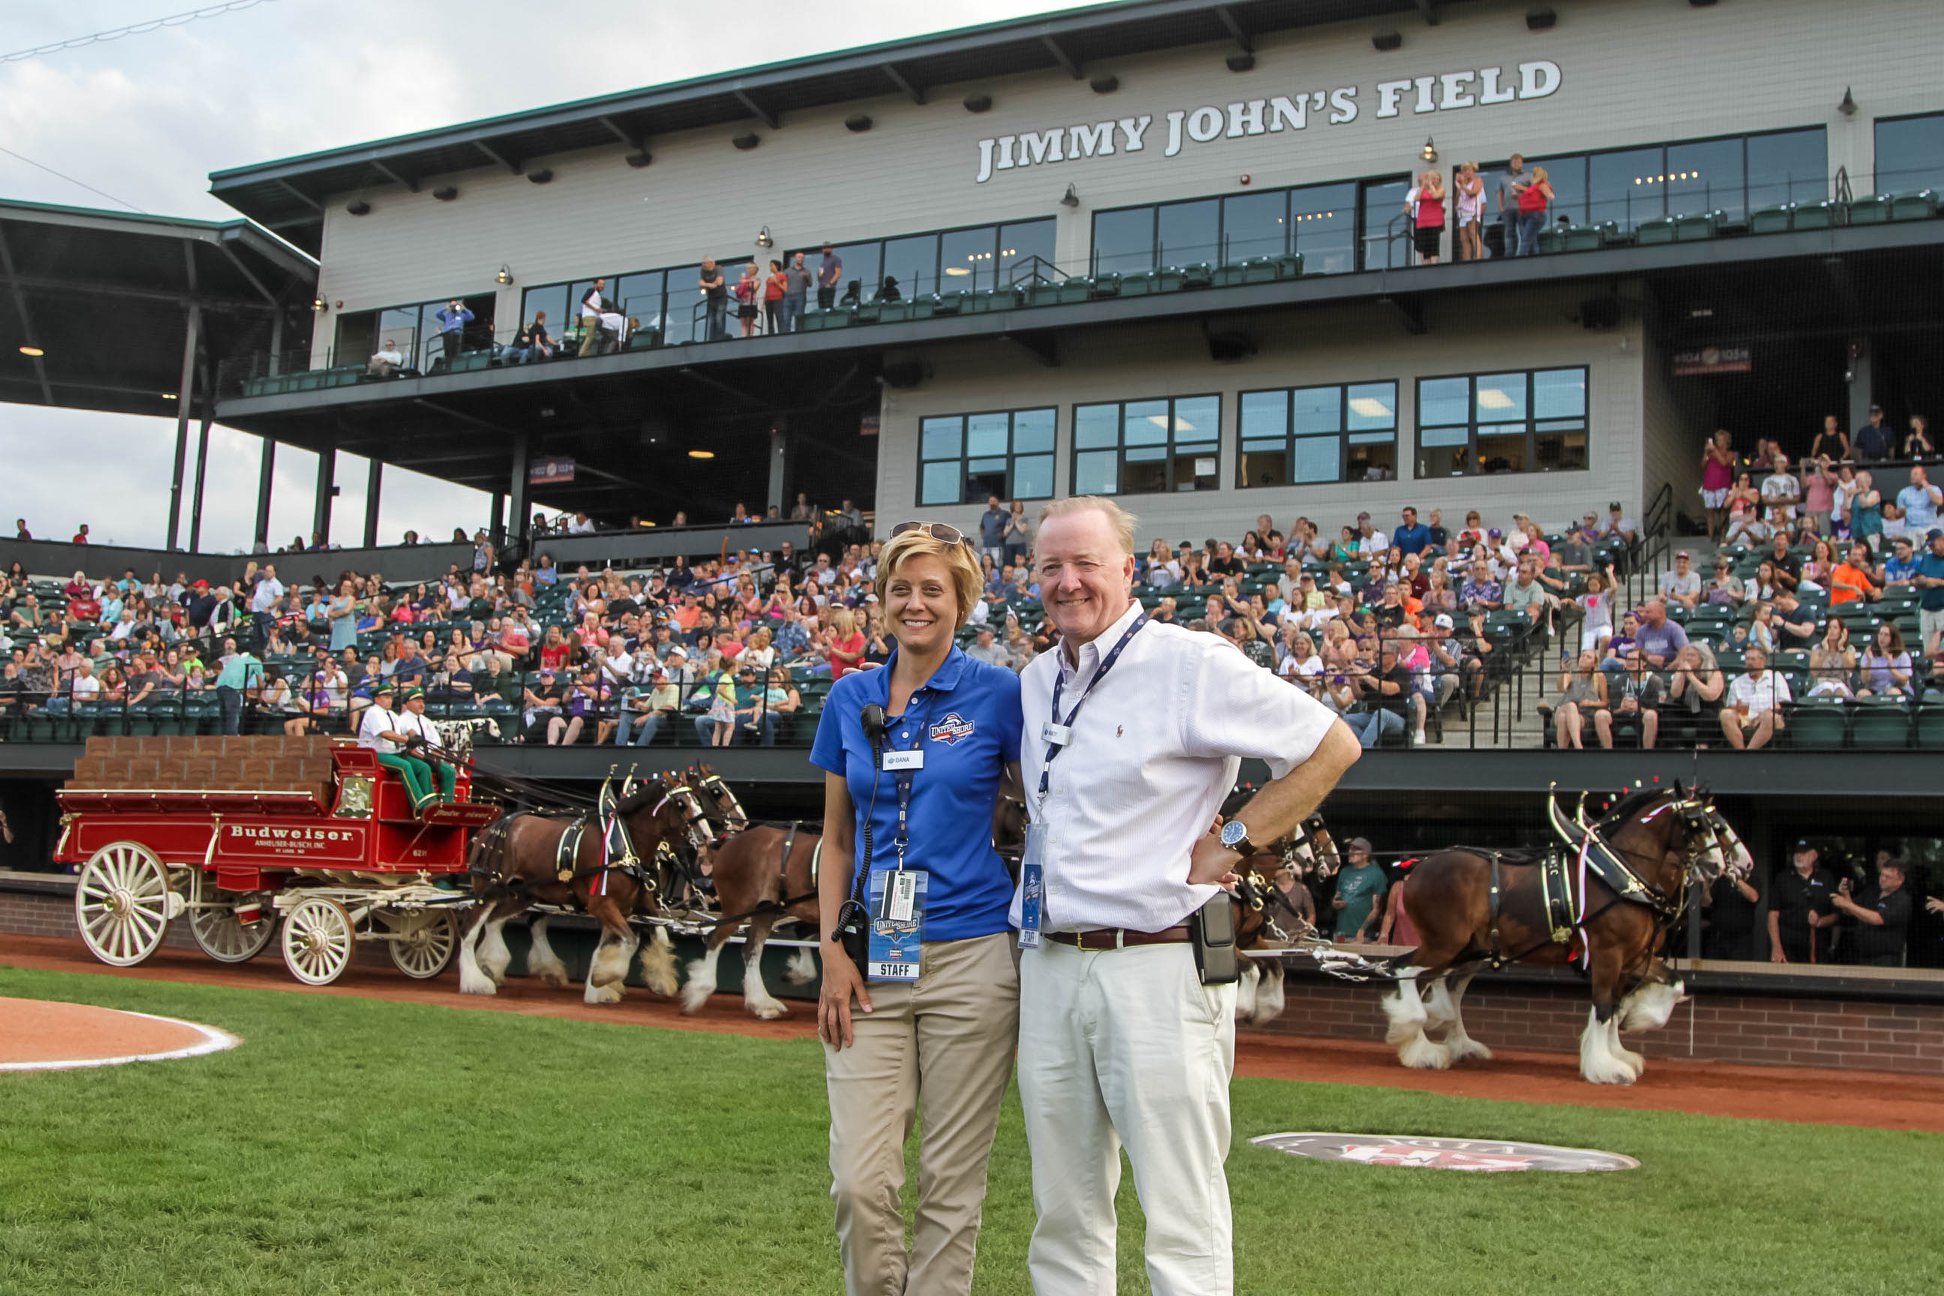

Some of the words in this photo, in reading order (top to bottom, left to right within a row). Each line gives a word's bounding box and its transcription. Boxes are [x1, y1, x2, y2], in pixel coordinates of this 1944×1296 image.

[975, 114, 1153, 184] JIMMY
[1164, 85, 1360, 158] JOHN'S
[1375, 59, 1564, 120] FIELD
[231, 825, 354, 841] Budweiser
[880, 964, 910, 976] STAFF
